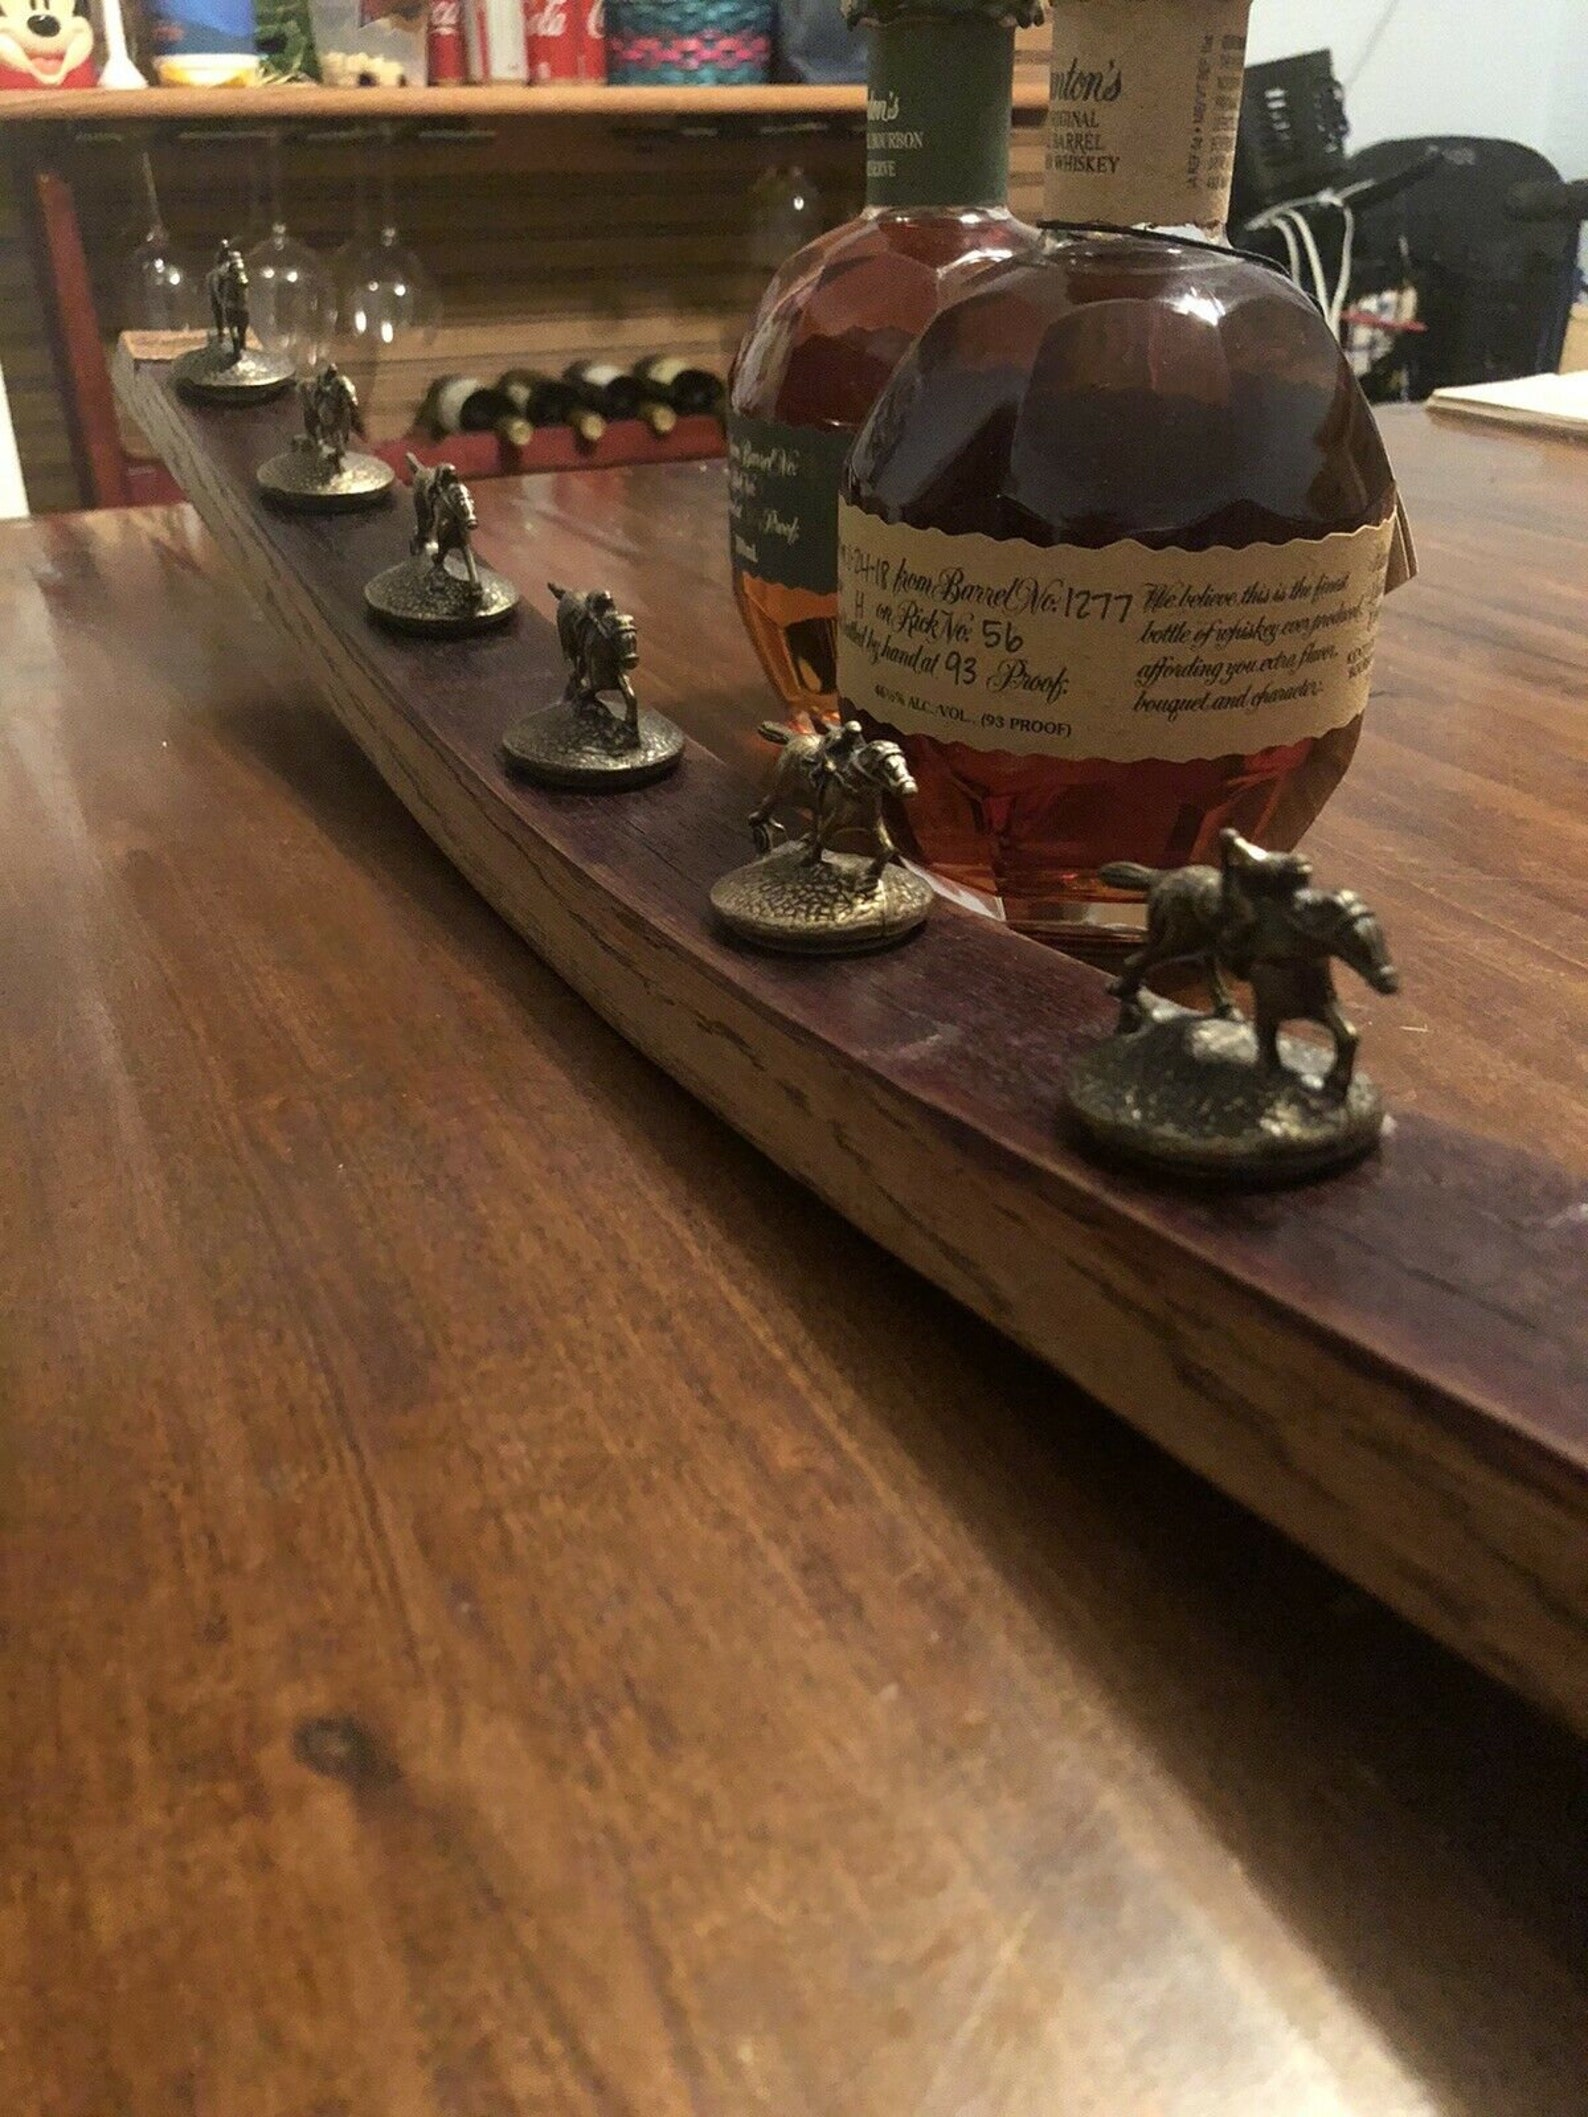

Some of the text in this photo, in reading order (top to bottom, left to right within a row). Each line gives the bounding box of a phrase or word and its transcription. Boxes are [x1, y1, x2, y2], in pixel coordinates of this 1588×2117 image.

[1054, 154, 1120, 174] WHISKEY
[892, 557, 931, 597] from
[932, 567, 1019, 611] Barrel
[1064, 587, 1133, 623] 1277
[1178, 584, 1237, 608] believe
[1237, 580, 1270, 606] this
[1271, 583, 1286, 602] is
[1290, 575, 1311, 600] the
[855, 590, 864, 619] H
[876, 603, 892, 624] on
[892, 601, 939, 639] Rick
[982, 619, 1023, 653] 56
[1137, 620, 1191, 645] bottle
[1215, 614, 1279, 650] whiskey
[881, 634, 923, 674] hand
[921, 653, 941, 677] at
[945, 650, 977, 685] 93
[1134, 656, 1224, 688] affording
[1220, 660, 1257, 685] you
[1259, 651, 1297, 676] extra
[1133, 689, 1210, 723] bouquet
[1211, 684, 1252, 711] and
[981, 713, 1005, 729] (93
[1009, 718, 1072, 738] PROOF)
